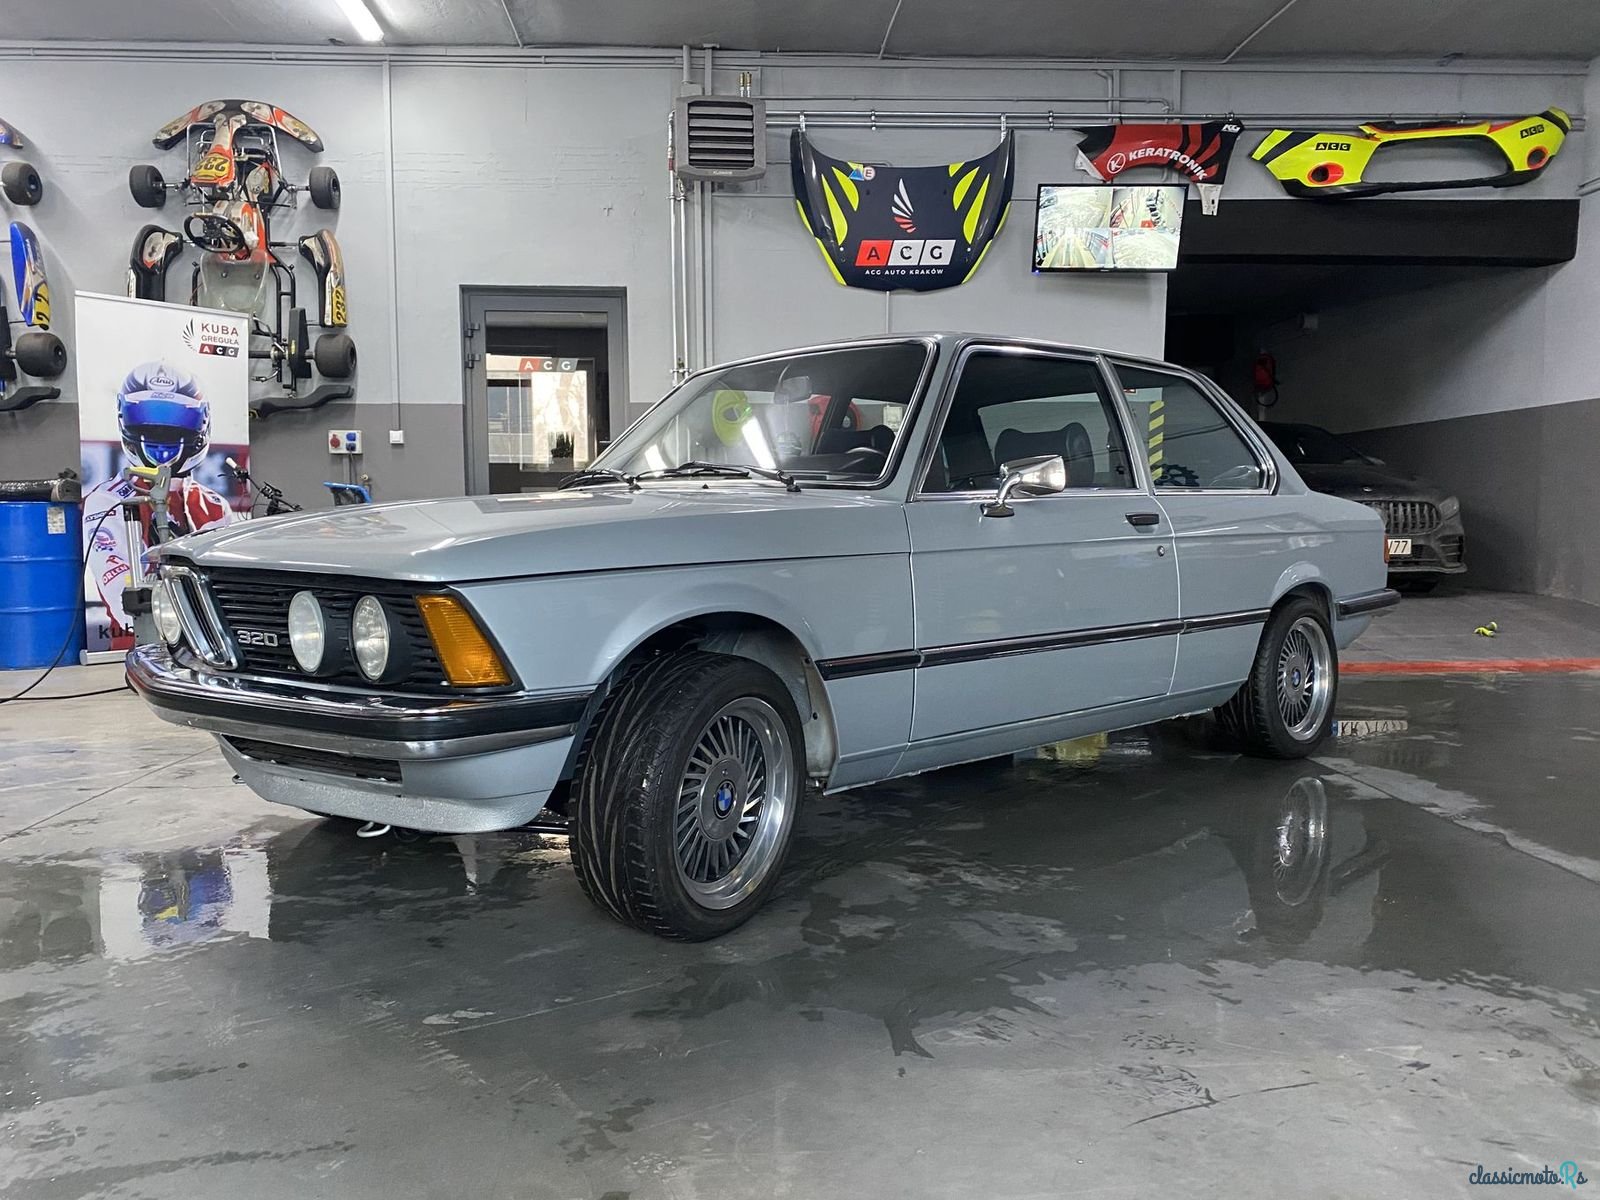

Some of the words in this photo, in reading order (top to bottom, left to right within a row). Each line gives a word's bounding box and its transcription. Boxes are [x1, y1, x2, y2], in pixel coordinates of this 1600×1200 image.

[1128, 147, 1208, 181] KERATRONIK
[866, 245, 943, 261] ACG
[201, 322, 239, 336] KUBA
[202, 345, 236, 356] ACG
[523, 360, 572, 371] ACG
[103, 564, 129, 583] ORLEN
[237, 630, 278, 647] 320
